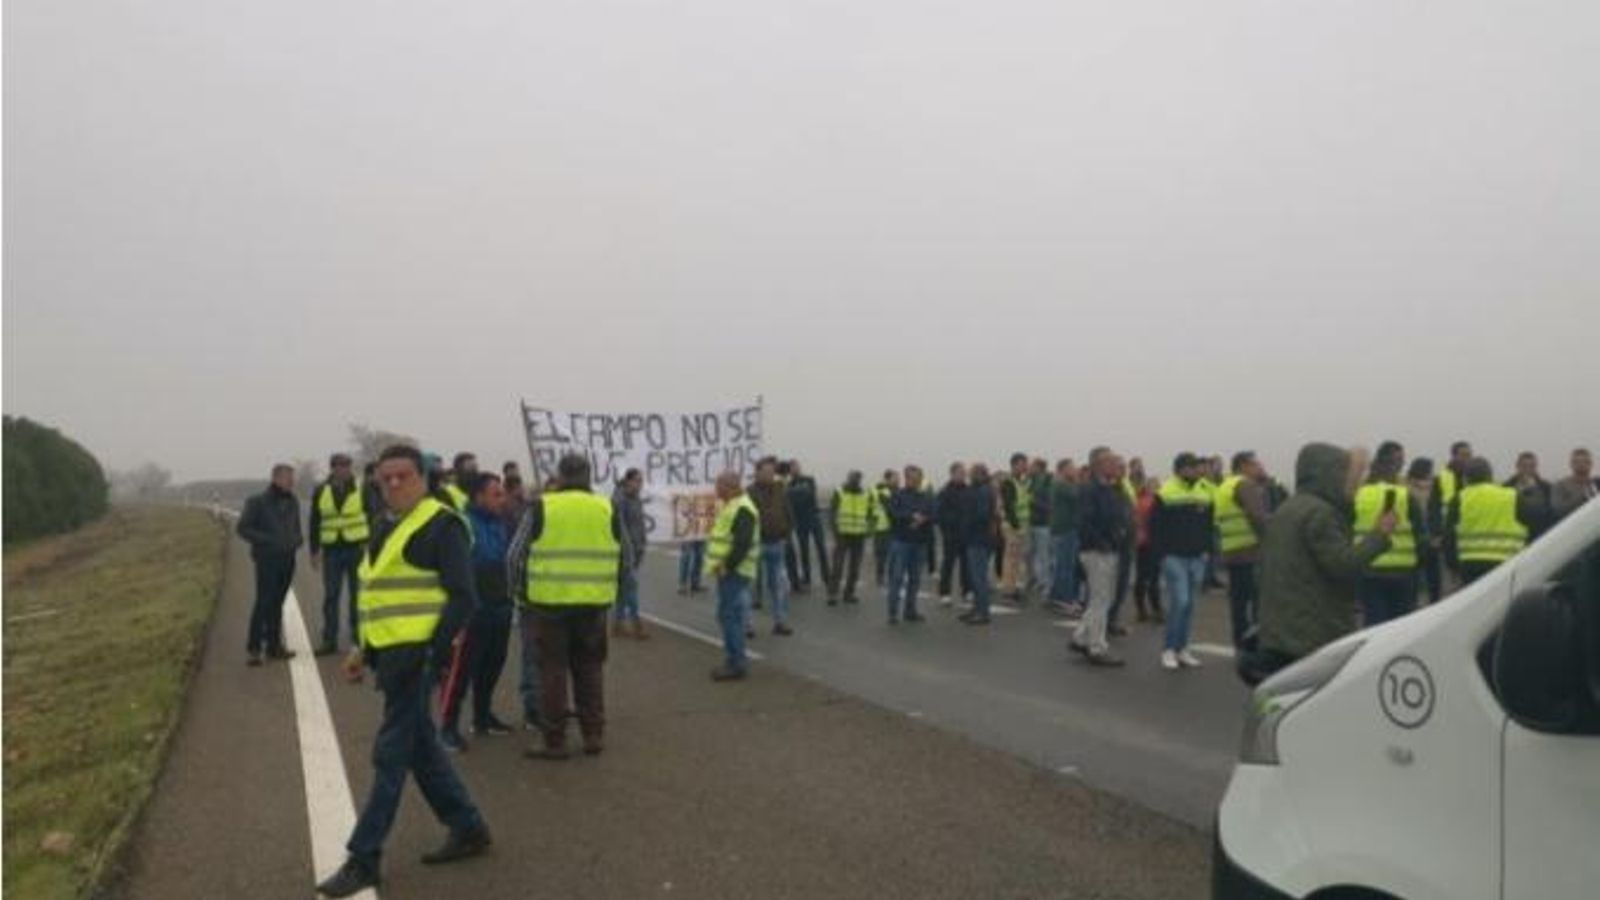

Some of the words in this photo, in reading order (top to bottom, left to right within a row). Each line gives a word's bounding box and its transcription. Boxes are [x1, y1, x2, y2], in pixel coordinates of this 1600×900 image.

[525, 408, 569, 443] EL
[570, 412, 667, 450] CAMPO
[682, 412, 720, 445] NO
[726, 406, 761, 442] SE
[1388, 673, 1426, 709] 10
